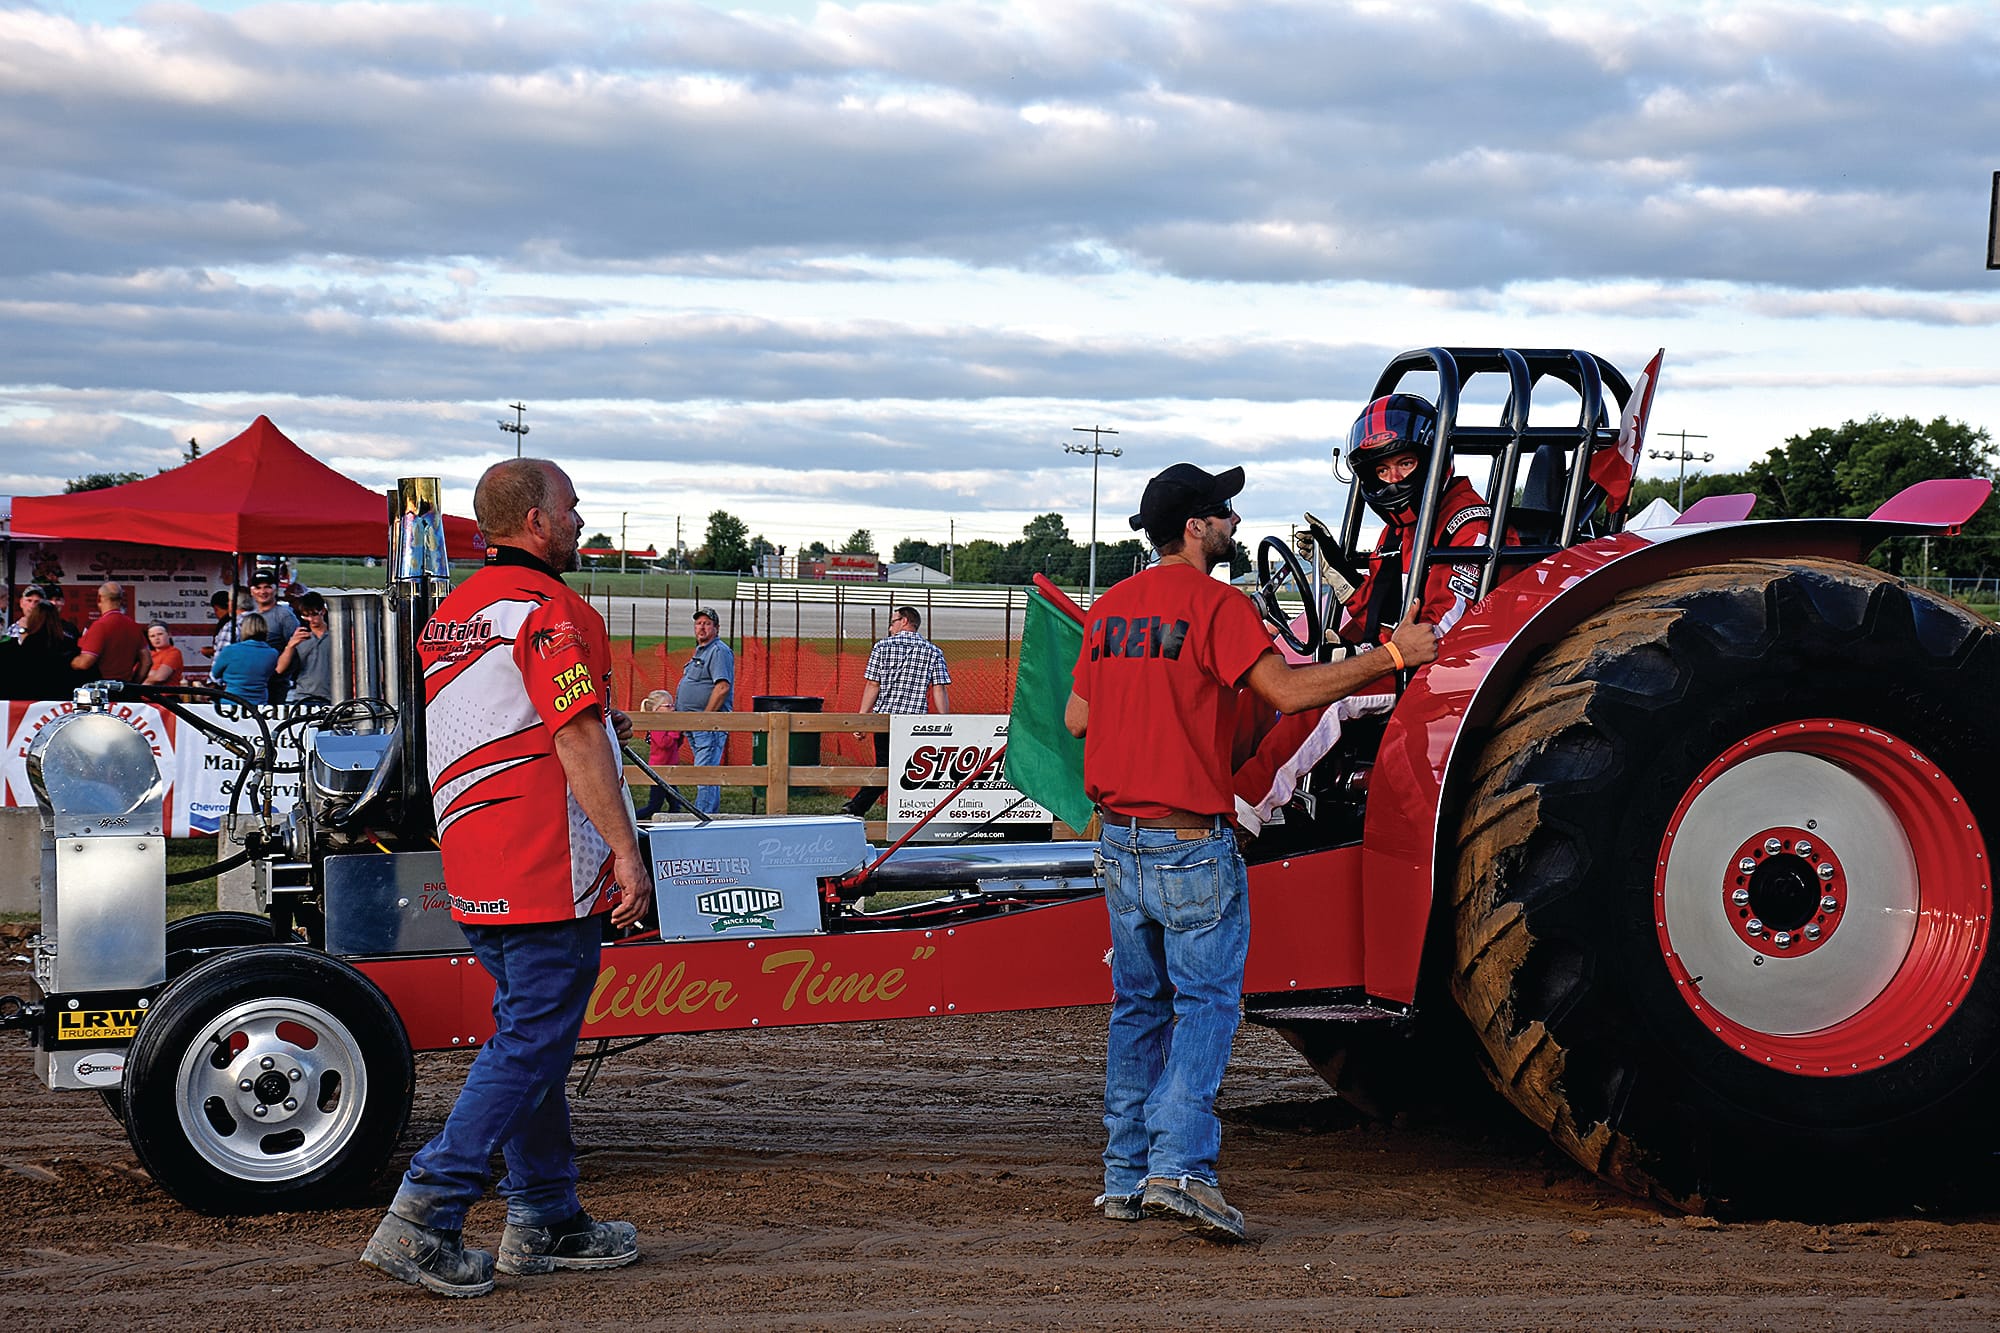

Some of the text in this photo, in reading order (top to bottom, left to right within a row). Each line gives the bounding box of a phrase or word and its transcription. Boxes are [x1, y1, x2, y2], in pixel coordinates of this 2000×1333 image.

[906, 745, 1006, 782] STOL
[220, 779, 233, 795] &
[973, 781, 980, 789] &
[958, 798, 984, 808] Elmira
[898, 811, 937, 819] 291-21
[757, 834, 835, 863] Pryde
[769, 857, 796, 865] TRUCK
[803, 855, 837, 864] SERVICE
[656, 857, 751, 880] KIESWETTER
[672, 875, 739, 886] Custom Farming
[723, 917, 744, 926] SINCE
[61, 1010, 145, 1029] LRW
[62, 1029, 100, 1038] TRUCK
